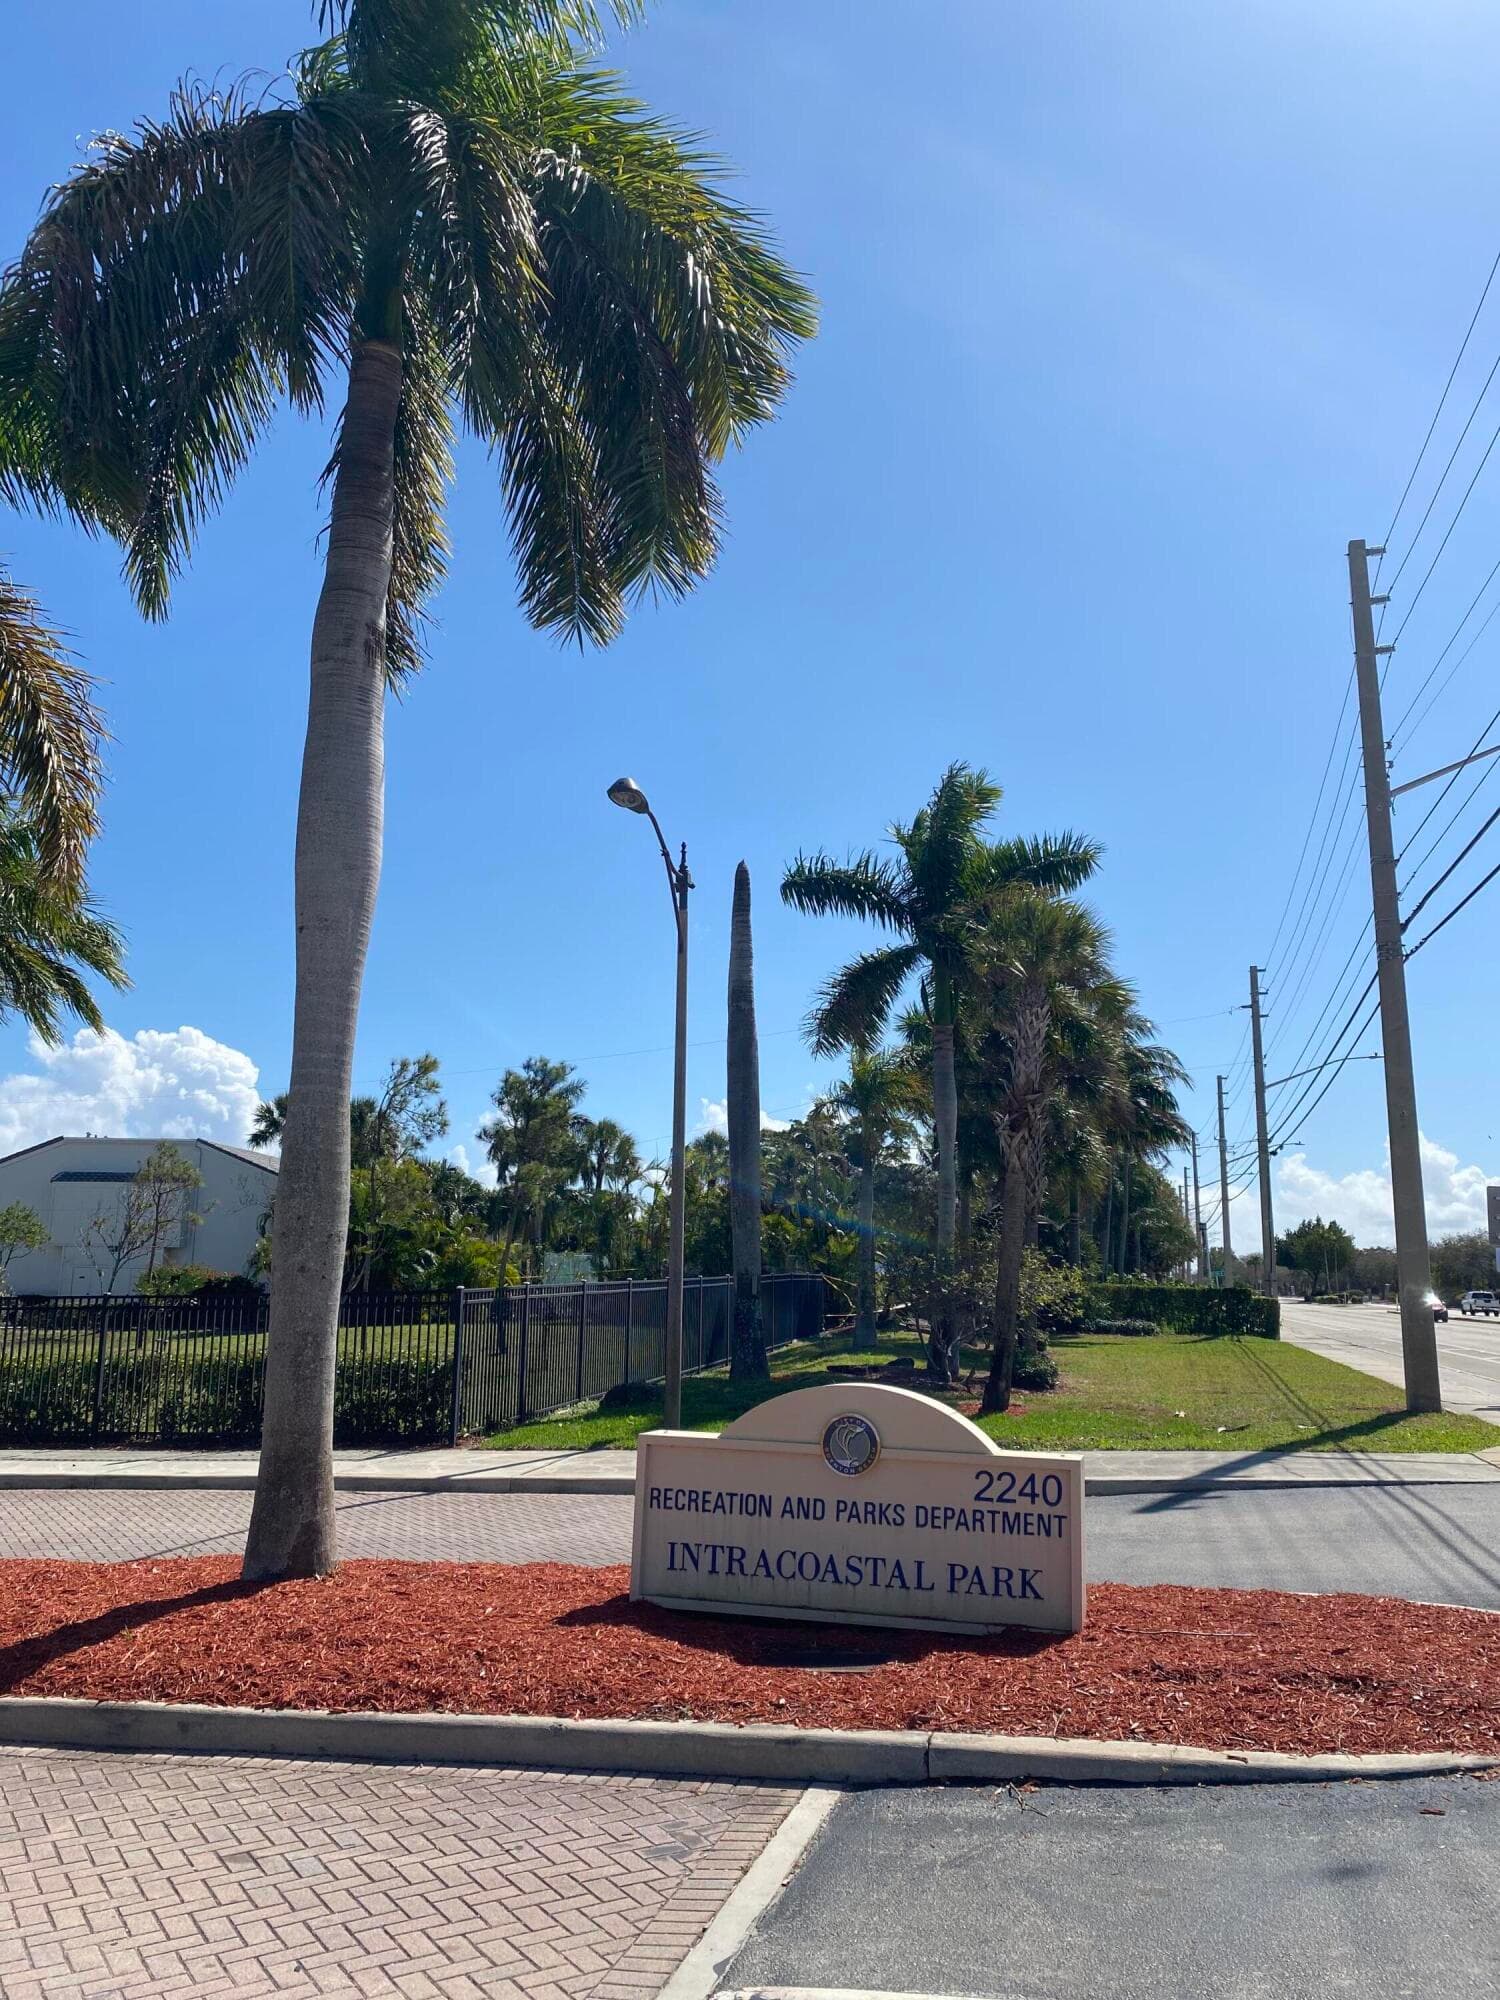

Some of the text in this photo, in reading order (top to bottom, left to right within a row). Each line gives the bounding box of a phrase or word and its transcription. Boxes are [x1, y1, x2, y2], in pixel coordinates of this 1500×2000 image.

[649, 1487, 1067, 1538] RECREATION AND PARKS DEPARTMENT
[974, 1471, 1063, 1507] 2240
[667, 1541, 1043, 1600] INTRACOASTAL PARK
